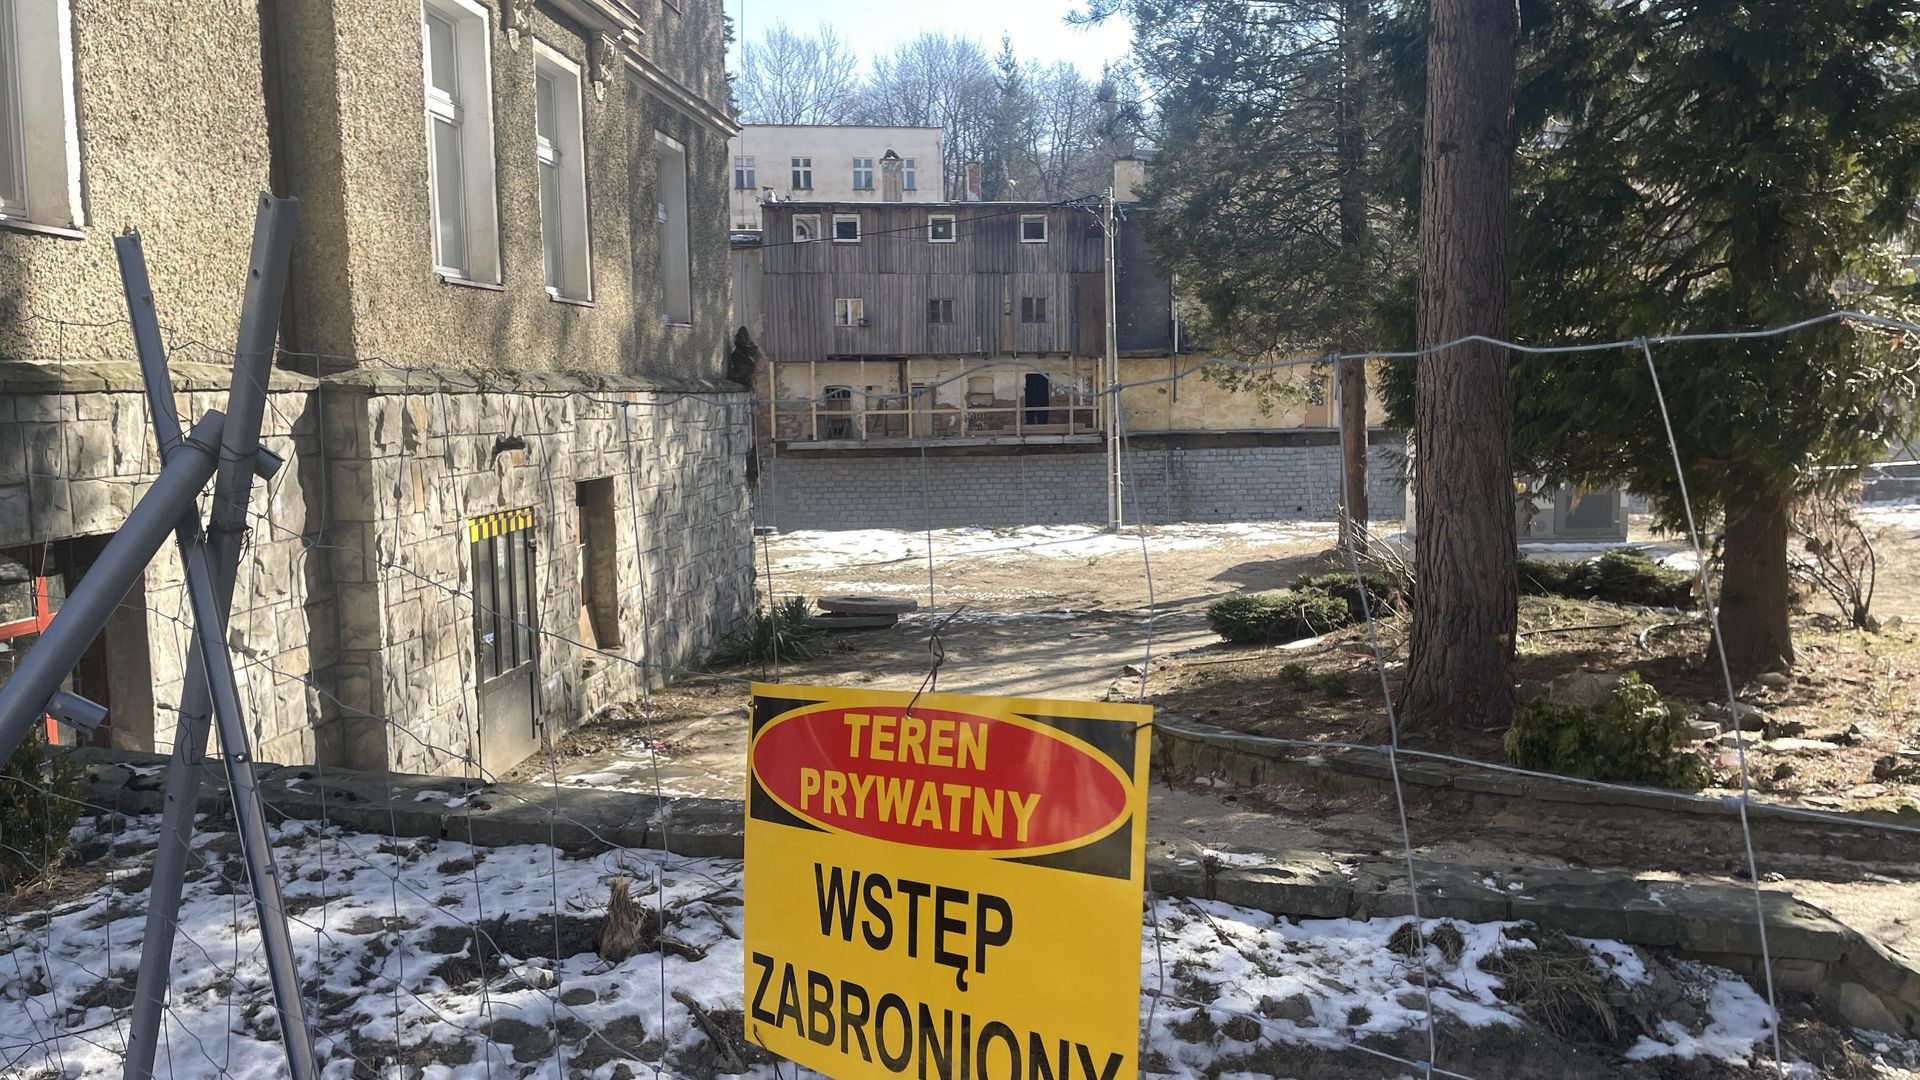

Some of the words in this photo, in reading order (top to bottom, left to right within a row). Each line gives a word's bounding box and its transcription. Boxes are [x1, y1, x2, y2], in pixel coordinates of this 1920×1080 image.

[843, 713, 988, 771] TEREN
[800, 767, 1041, 842] PRYWATNY
[813, 862, 1013, 992] WSTĘP
